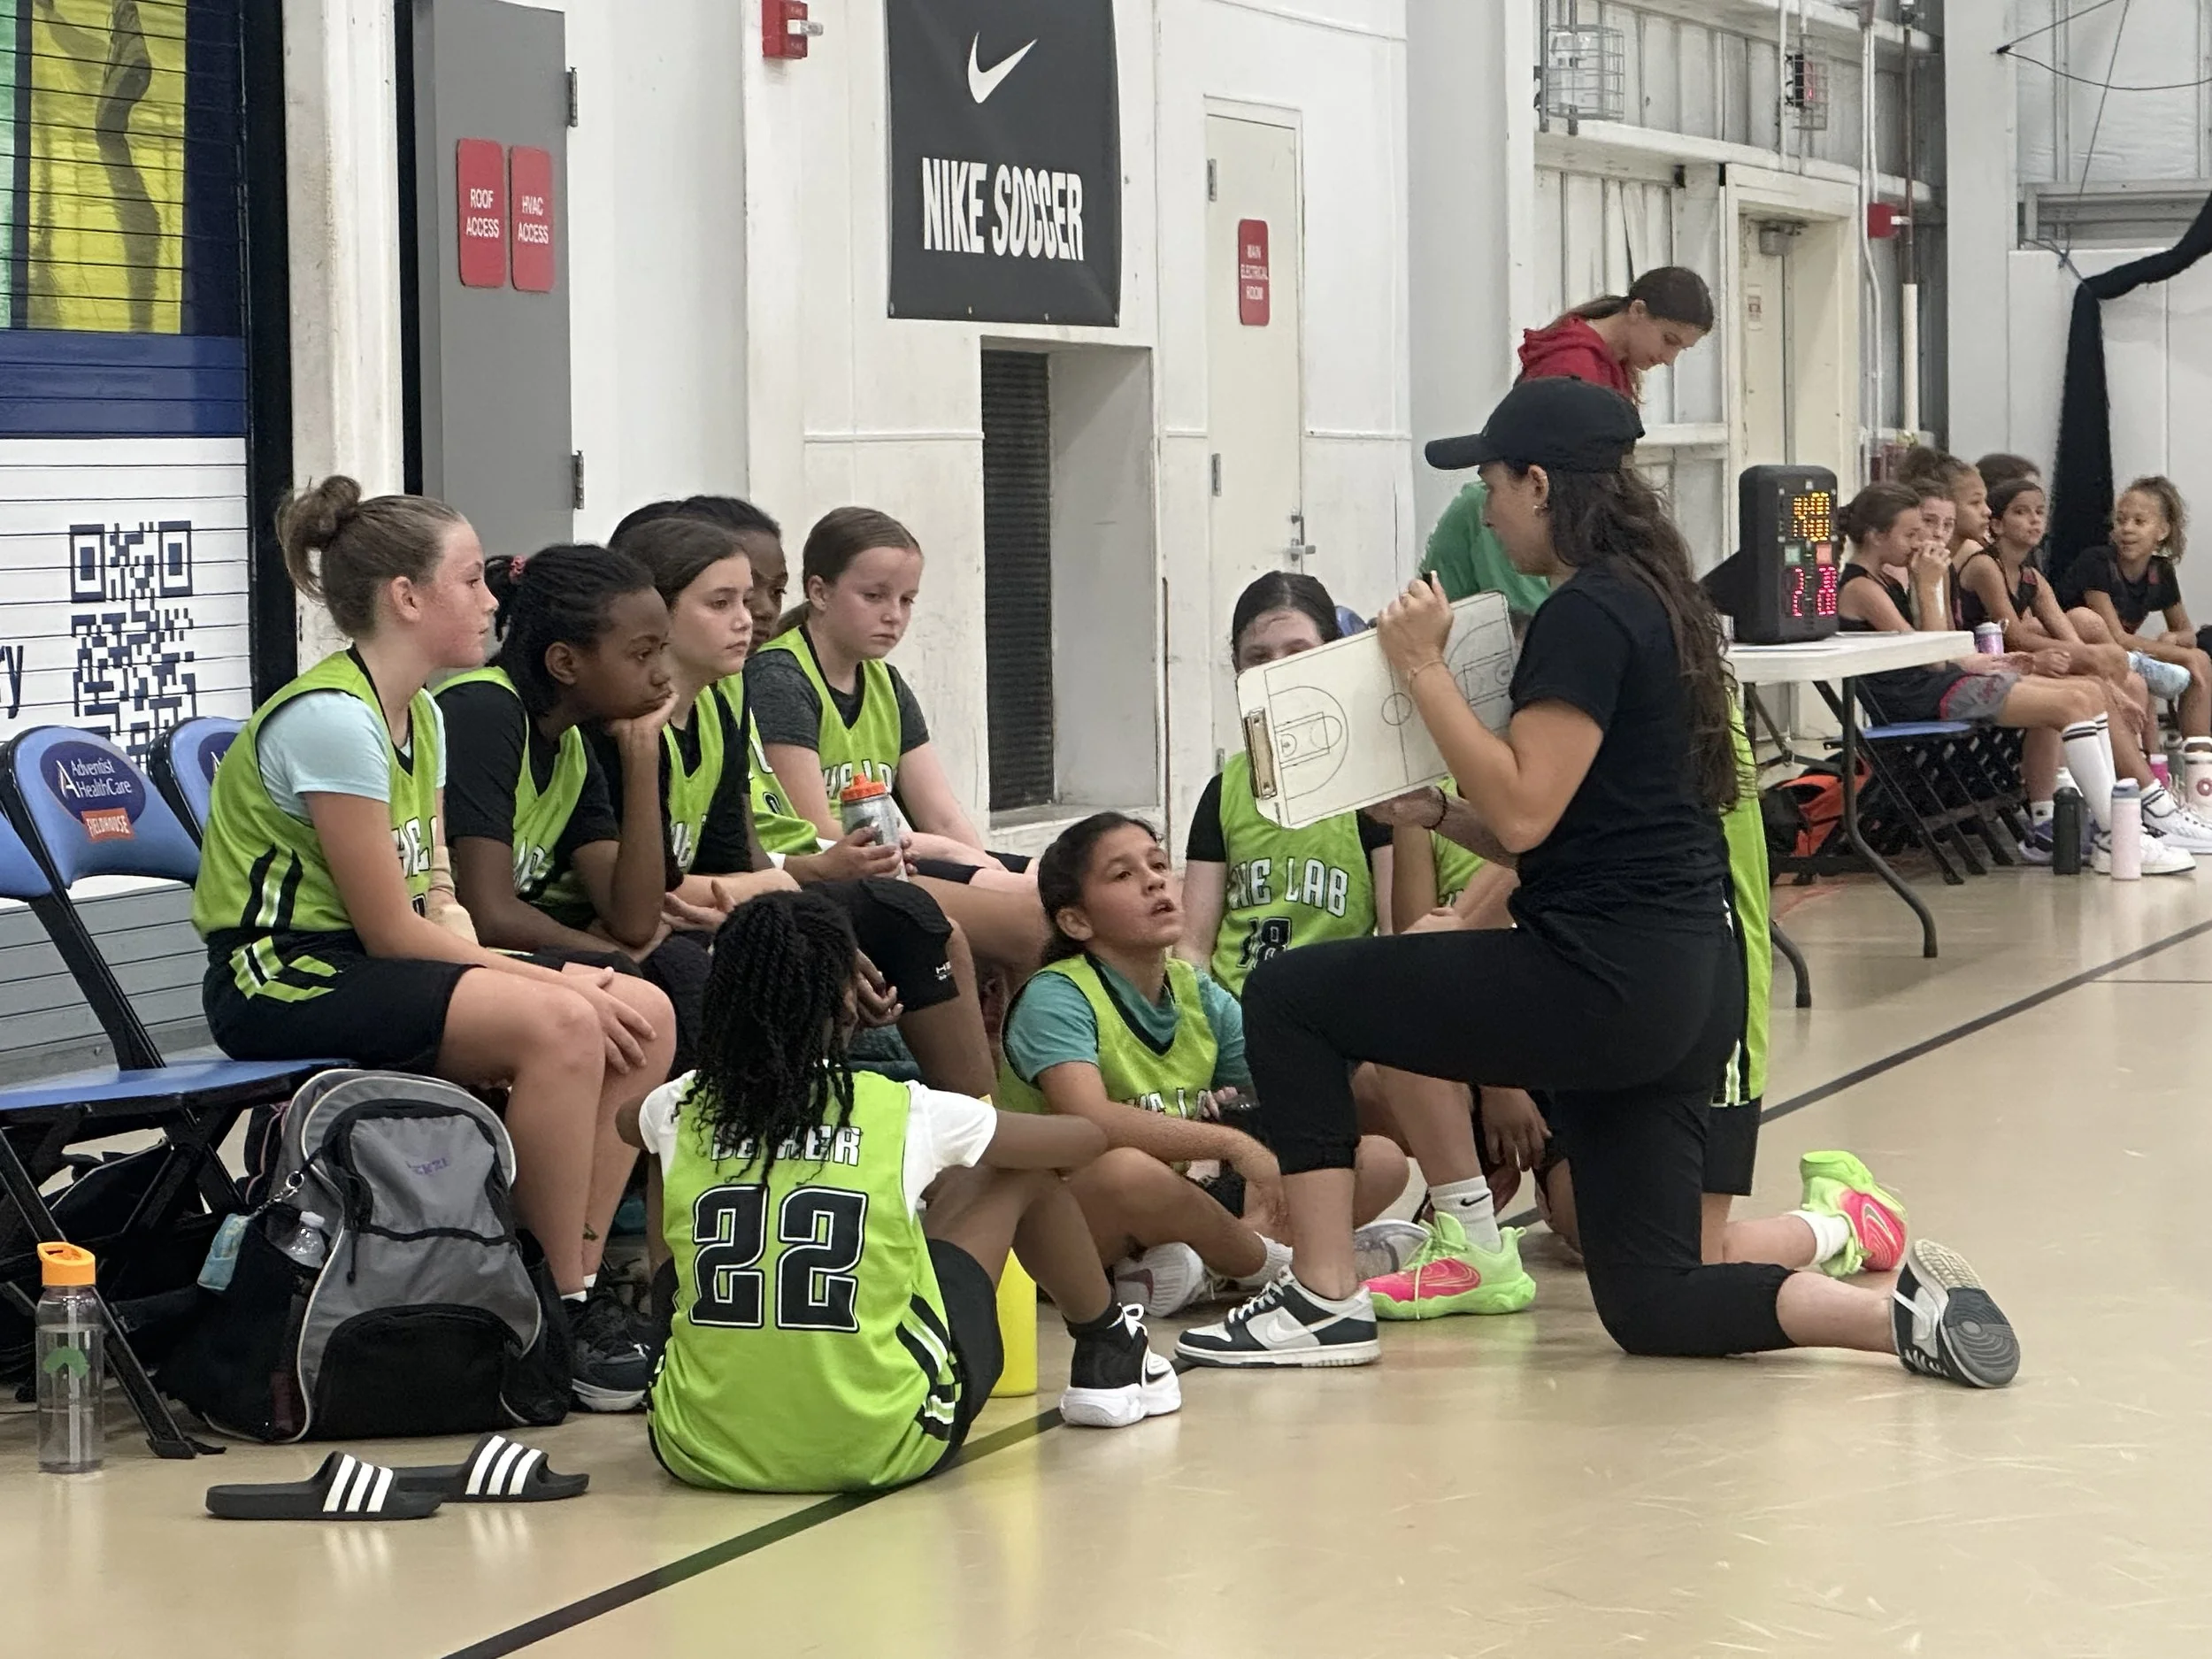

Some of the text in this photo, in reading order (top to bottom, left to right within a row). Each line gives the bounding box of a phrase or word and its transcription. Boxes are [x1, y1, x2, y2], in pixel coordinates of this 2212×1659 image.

[470, 188, 494, 209] ROOF
[521, 196, 544, 216] HVAC
[922, 157, 1084, 261] NIKE SOCCER
[465, 217, 500, 239] ACCESS
[518, 222, 549, 244] ACCESS
[71, 757, 116, 777] Adventist
[76, 778, 133, 798] HealthCare
[1285, 856, 1349, 918] LAB
[688, 1184, 870, 1333] 22
